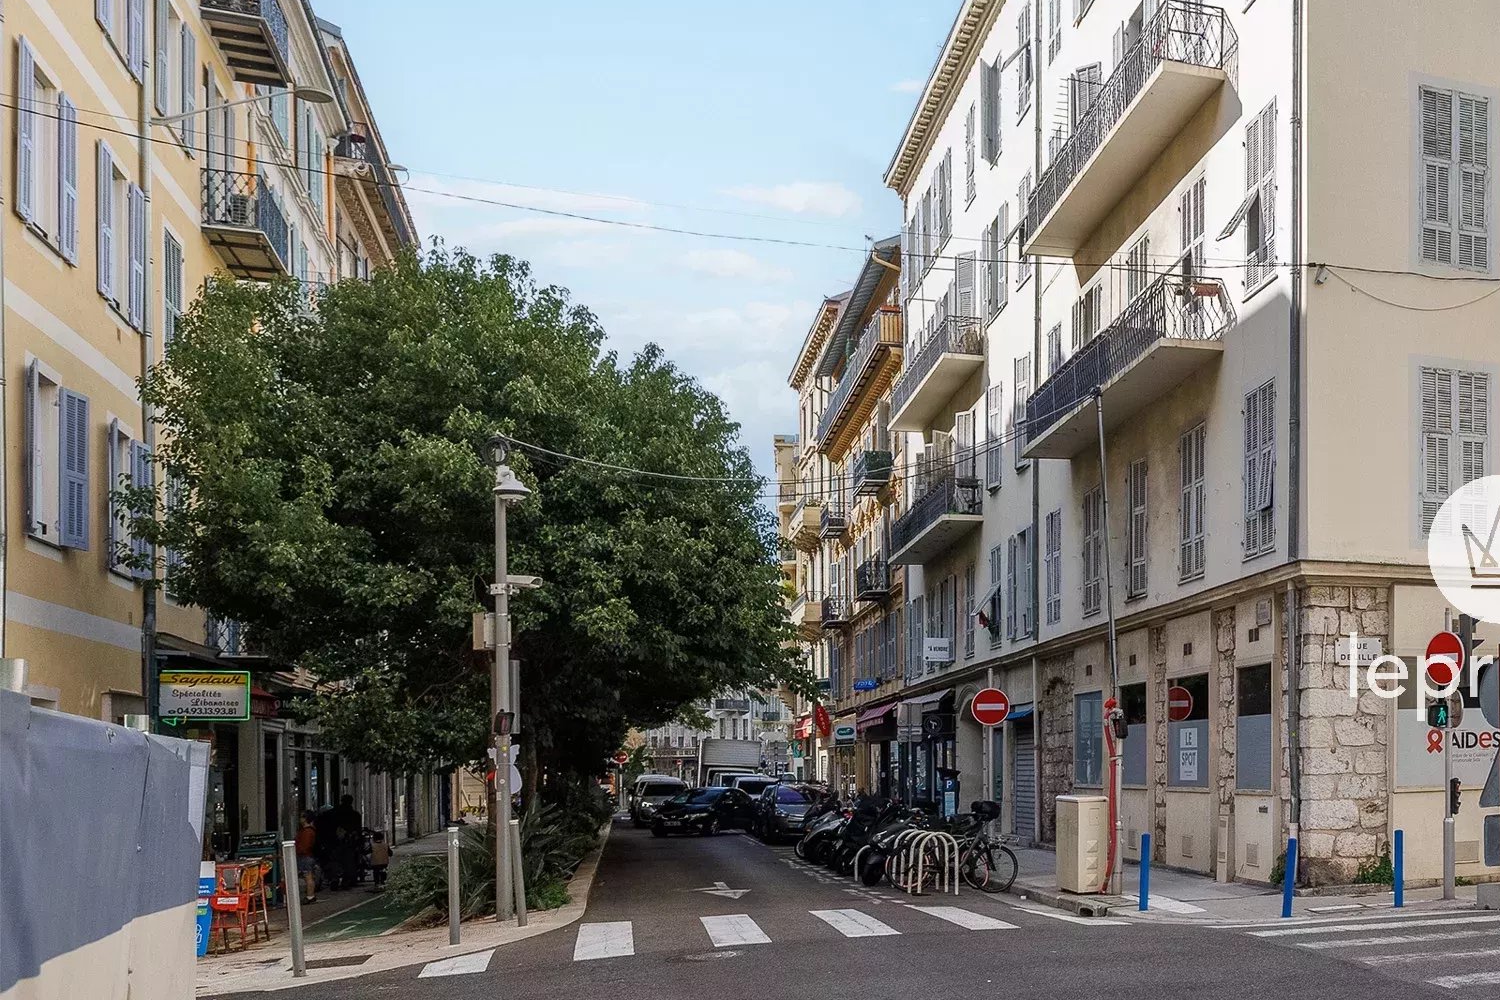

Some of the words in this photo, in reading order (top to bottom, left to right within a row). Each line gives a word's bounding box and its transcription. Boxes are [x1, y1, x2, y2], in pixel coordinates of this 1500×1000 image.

[172, 689, 222, 699] Spécialités
[191, 698, 239, 707] Libanaises
[1185, 731, 1193, 746] LE
[1181, 751, 1197, 767] SPOT
